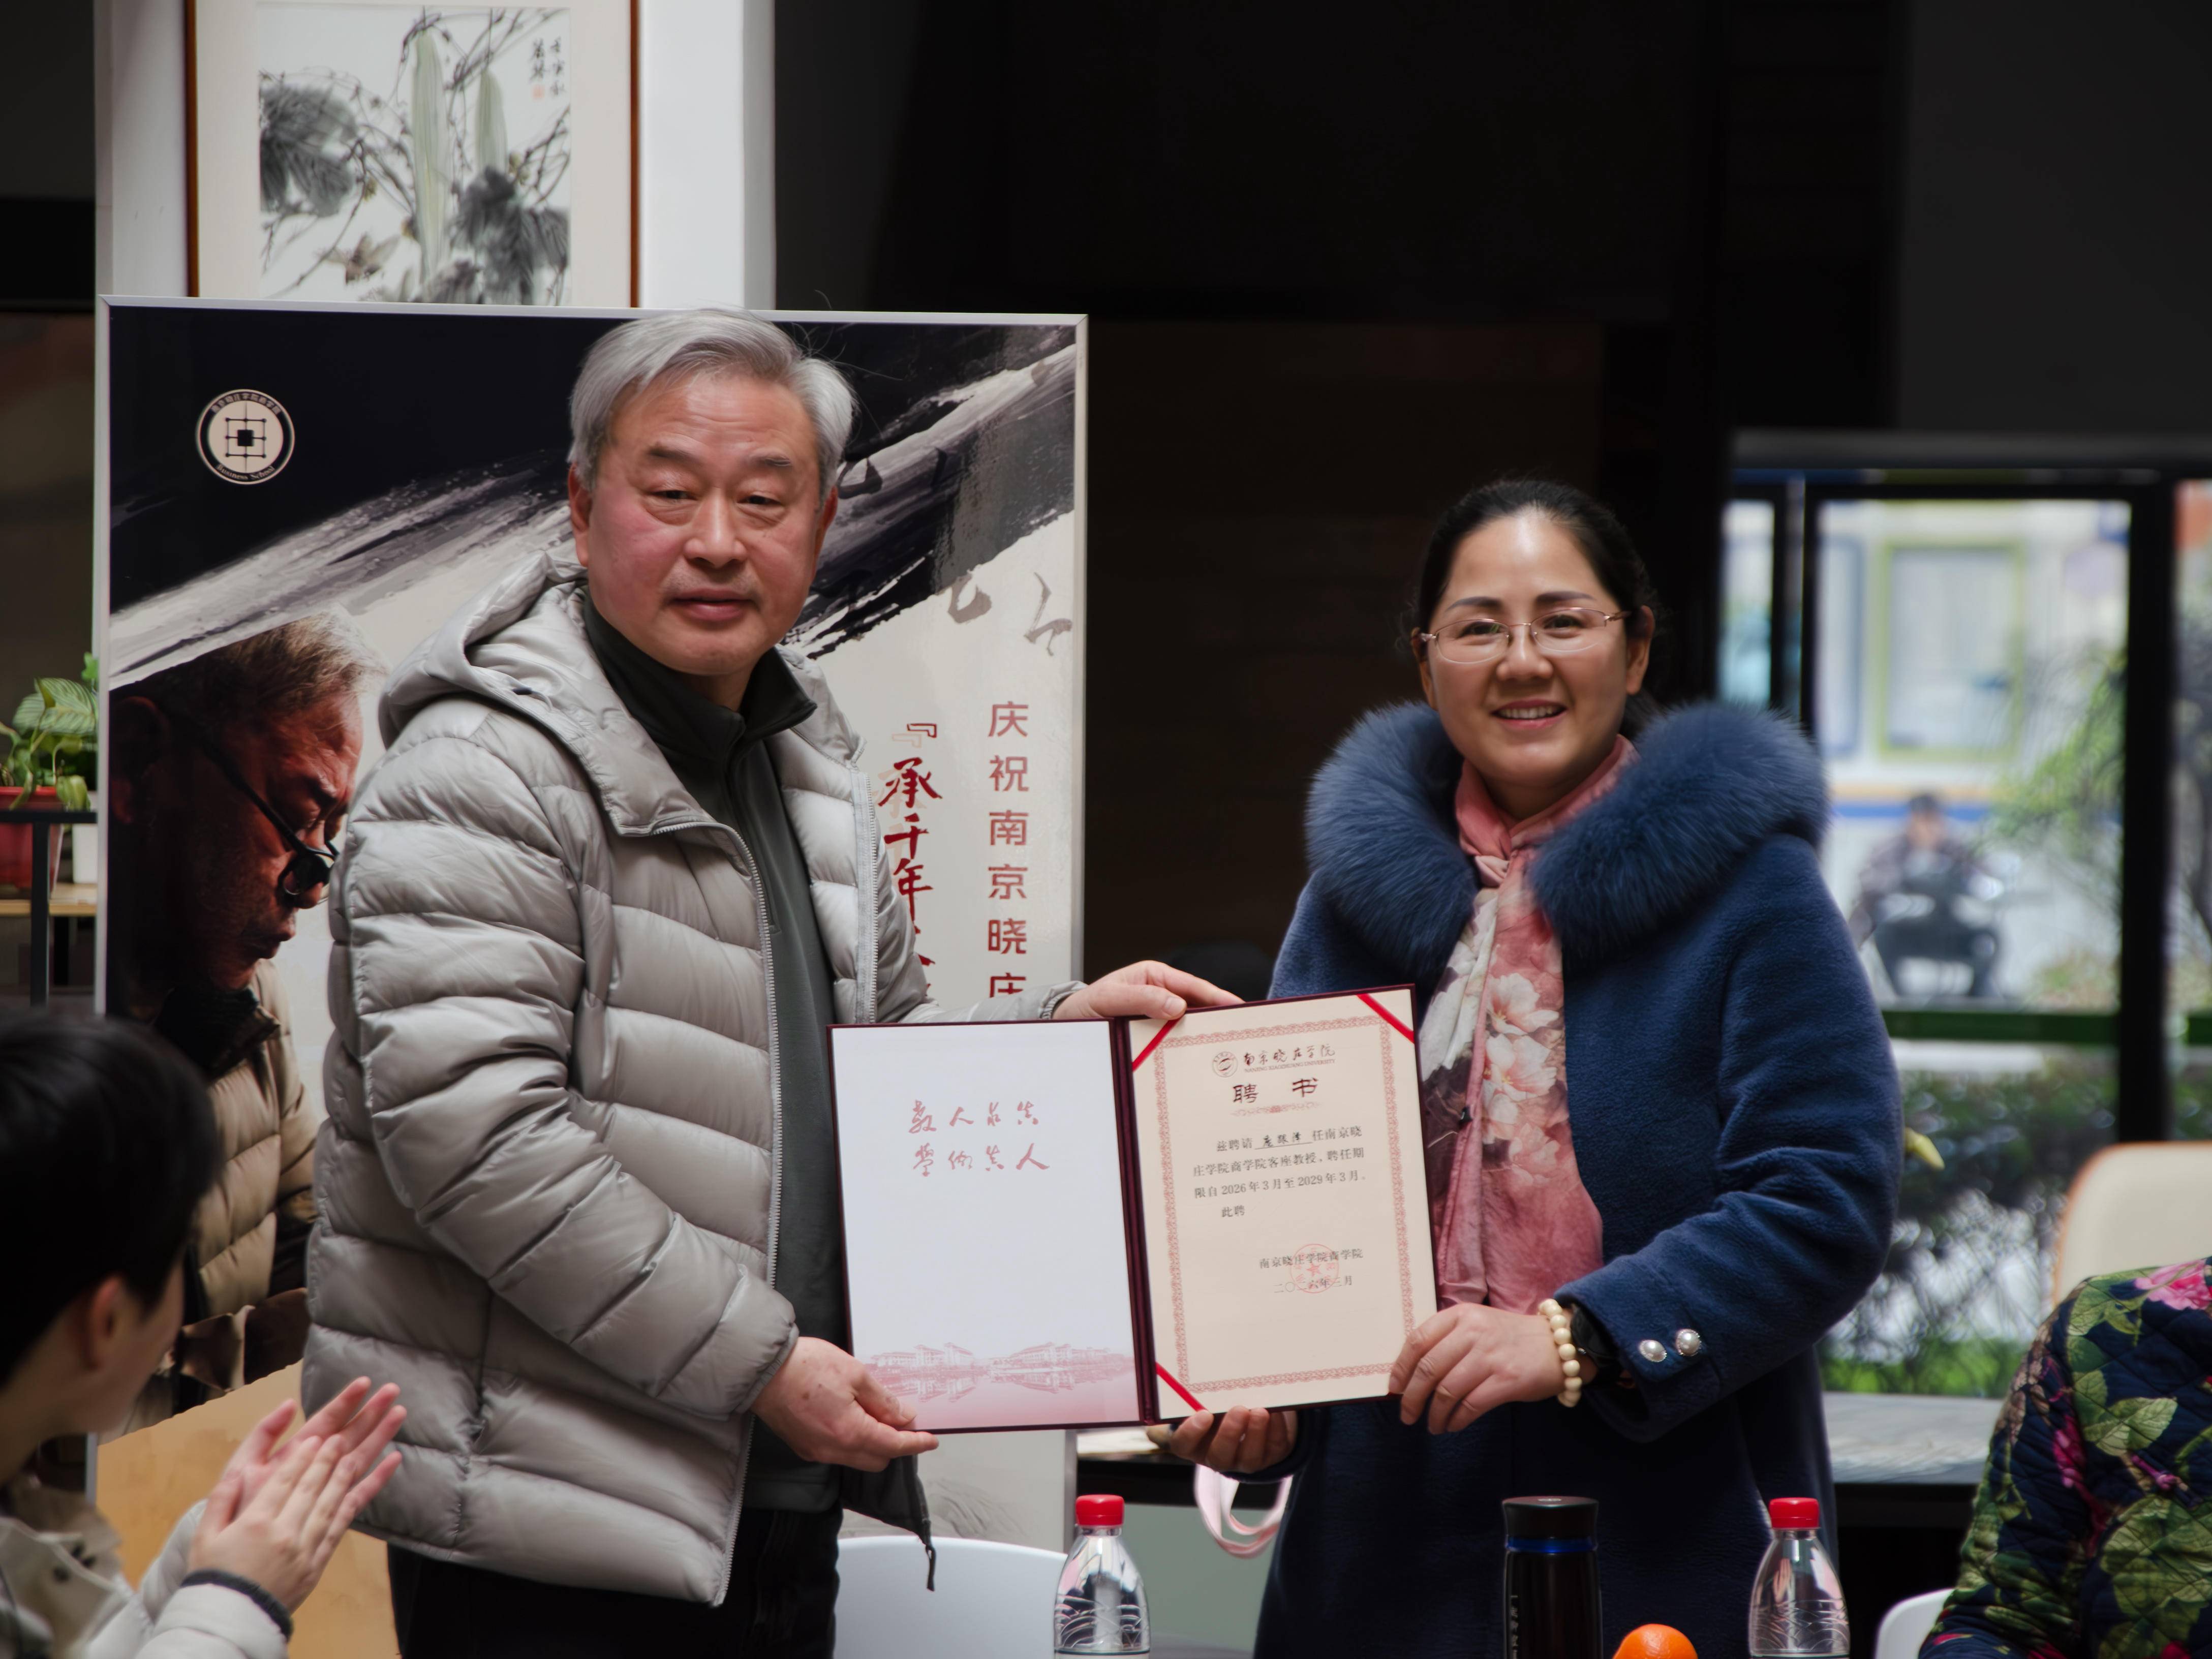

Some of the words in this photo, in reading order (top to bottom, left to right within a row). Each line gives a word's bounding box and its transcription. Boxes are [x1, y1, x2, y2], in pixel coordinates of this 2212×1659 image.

[250, 466, 275, 480] School
[1244, 1044, 1335, 1065] 南京晓庄学院
[1216, 1137, 1253, 1152] 兹聘请
[1312, 1125, 1363, 1142] 任南京晓
[1221, 1205, 1245, 1218] 此聘
[1259, 1248, 1364, 1269] 南京晓庄学院商学院
